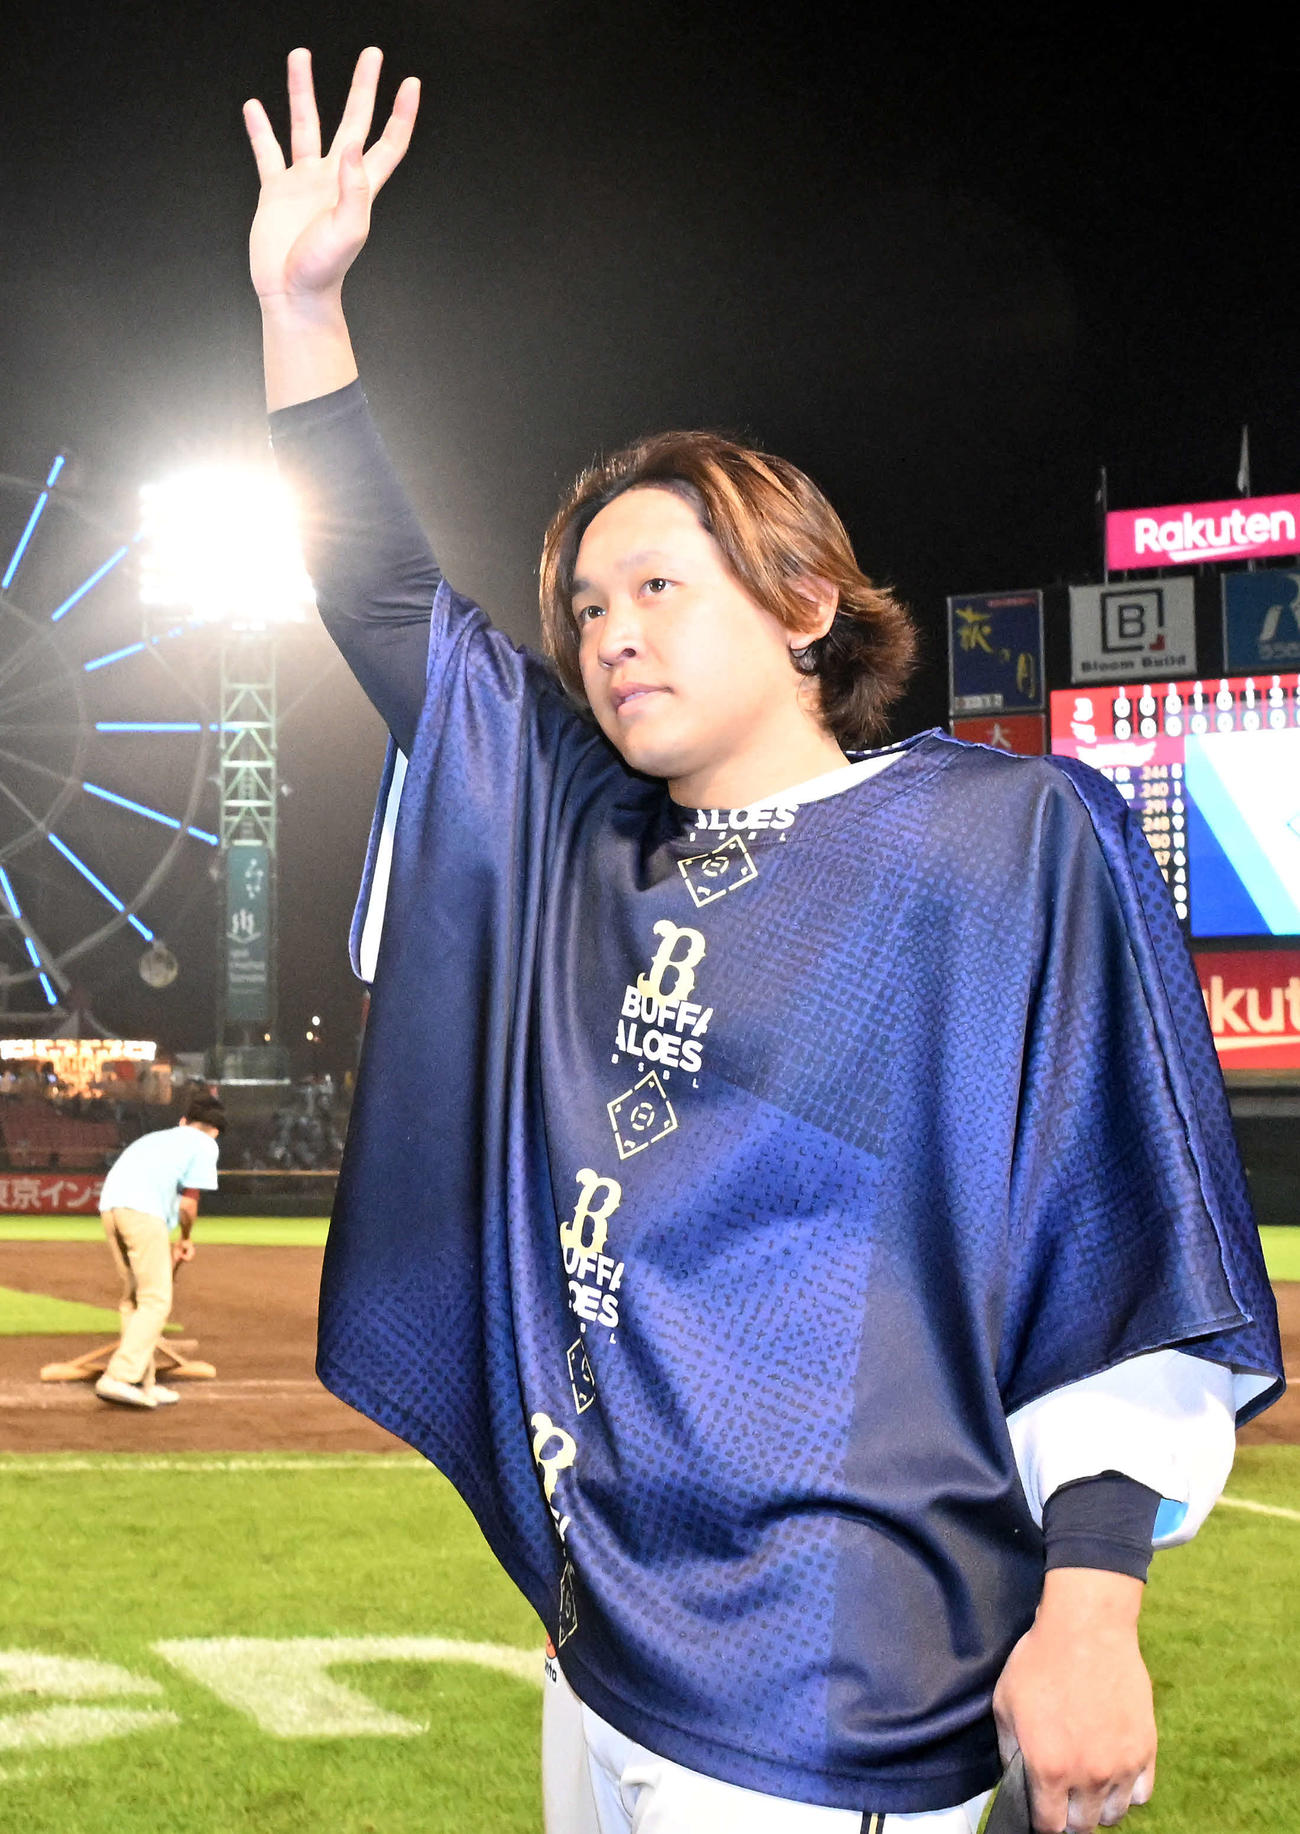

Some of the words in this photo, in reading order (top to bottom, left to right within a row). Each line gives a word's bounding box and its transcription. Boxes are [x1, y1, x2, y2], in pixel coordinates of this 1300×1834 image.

[1134, 509, 1296, 554] Rakuten
[1118, 605, 1144, 639] B
[637, 920, 706, 1003] B
[560, 1168, 622, 1254] B
